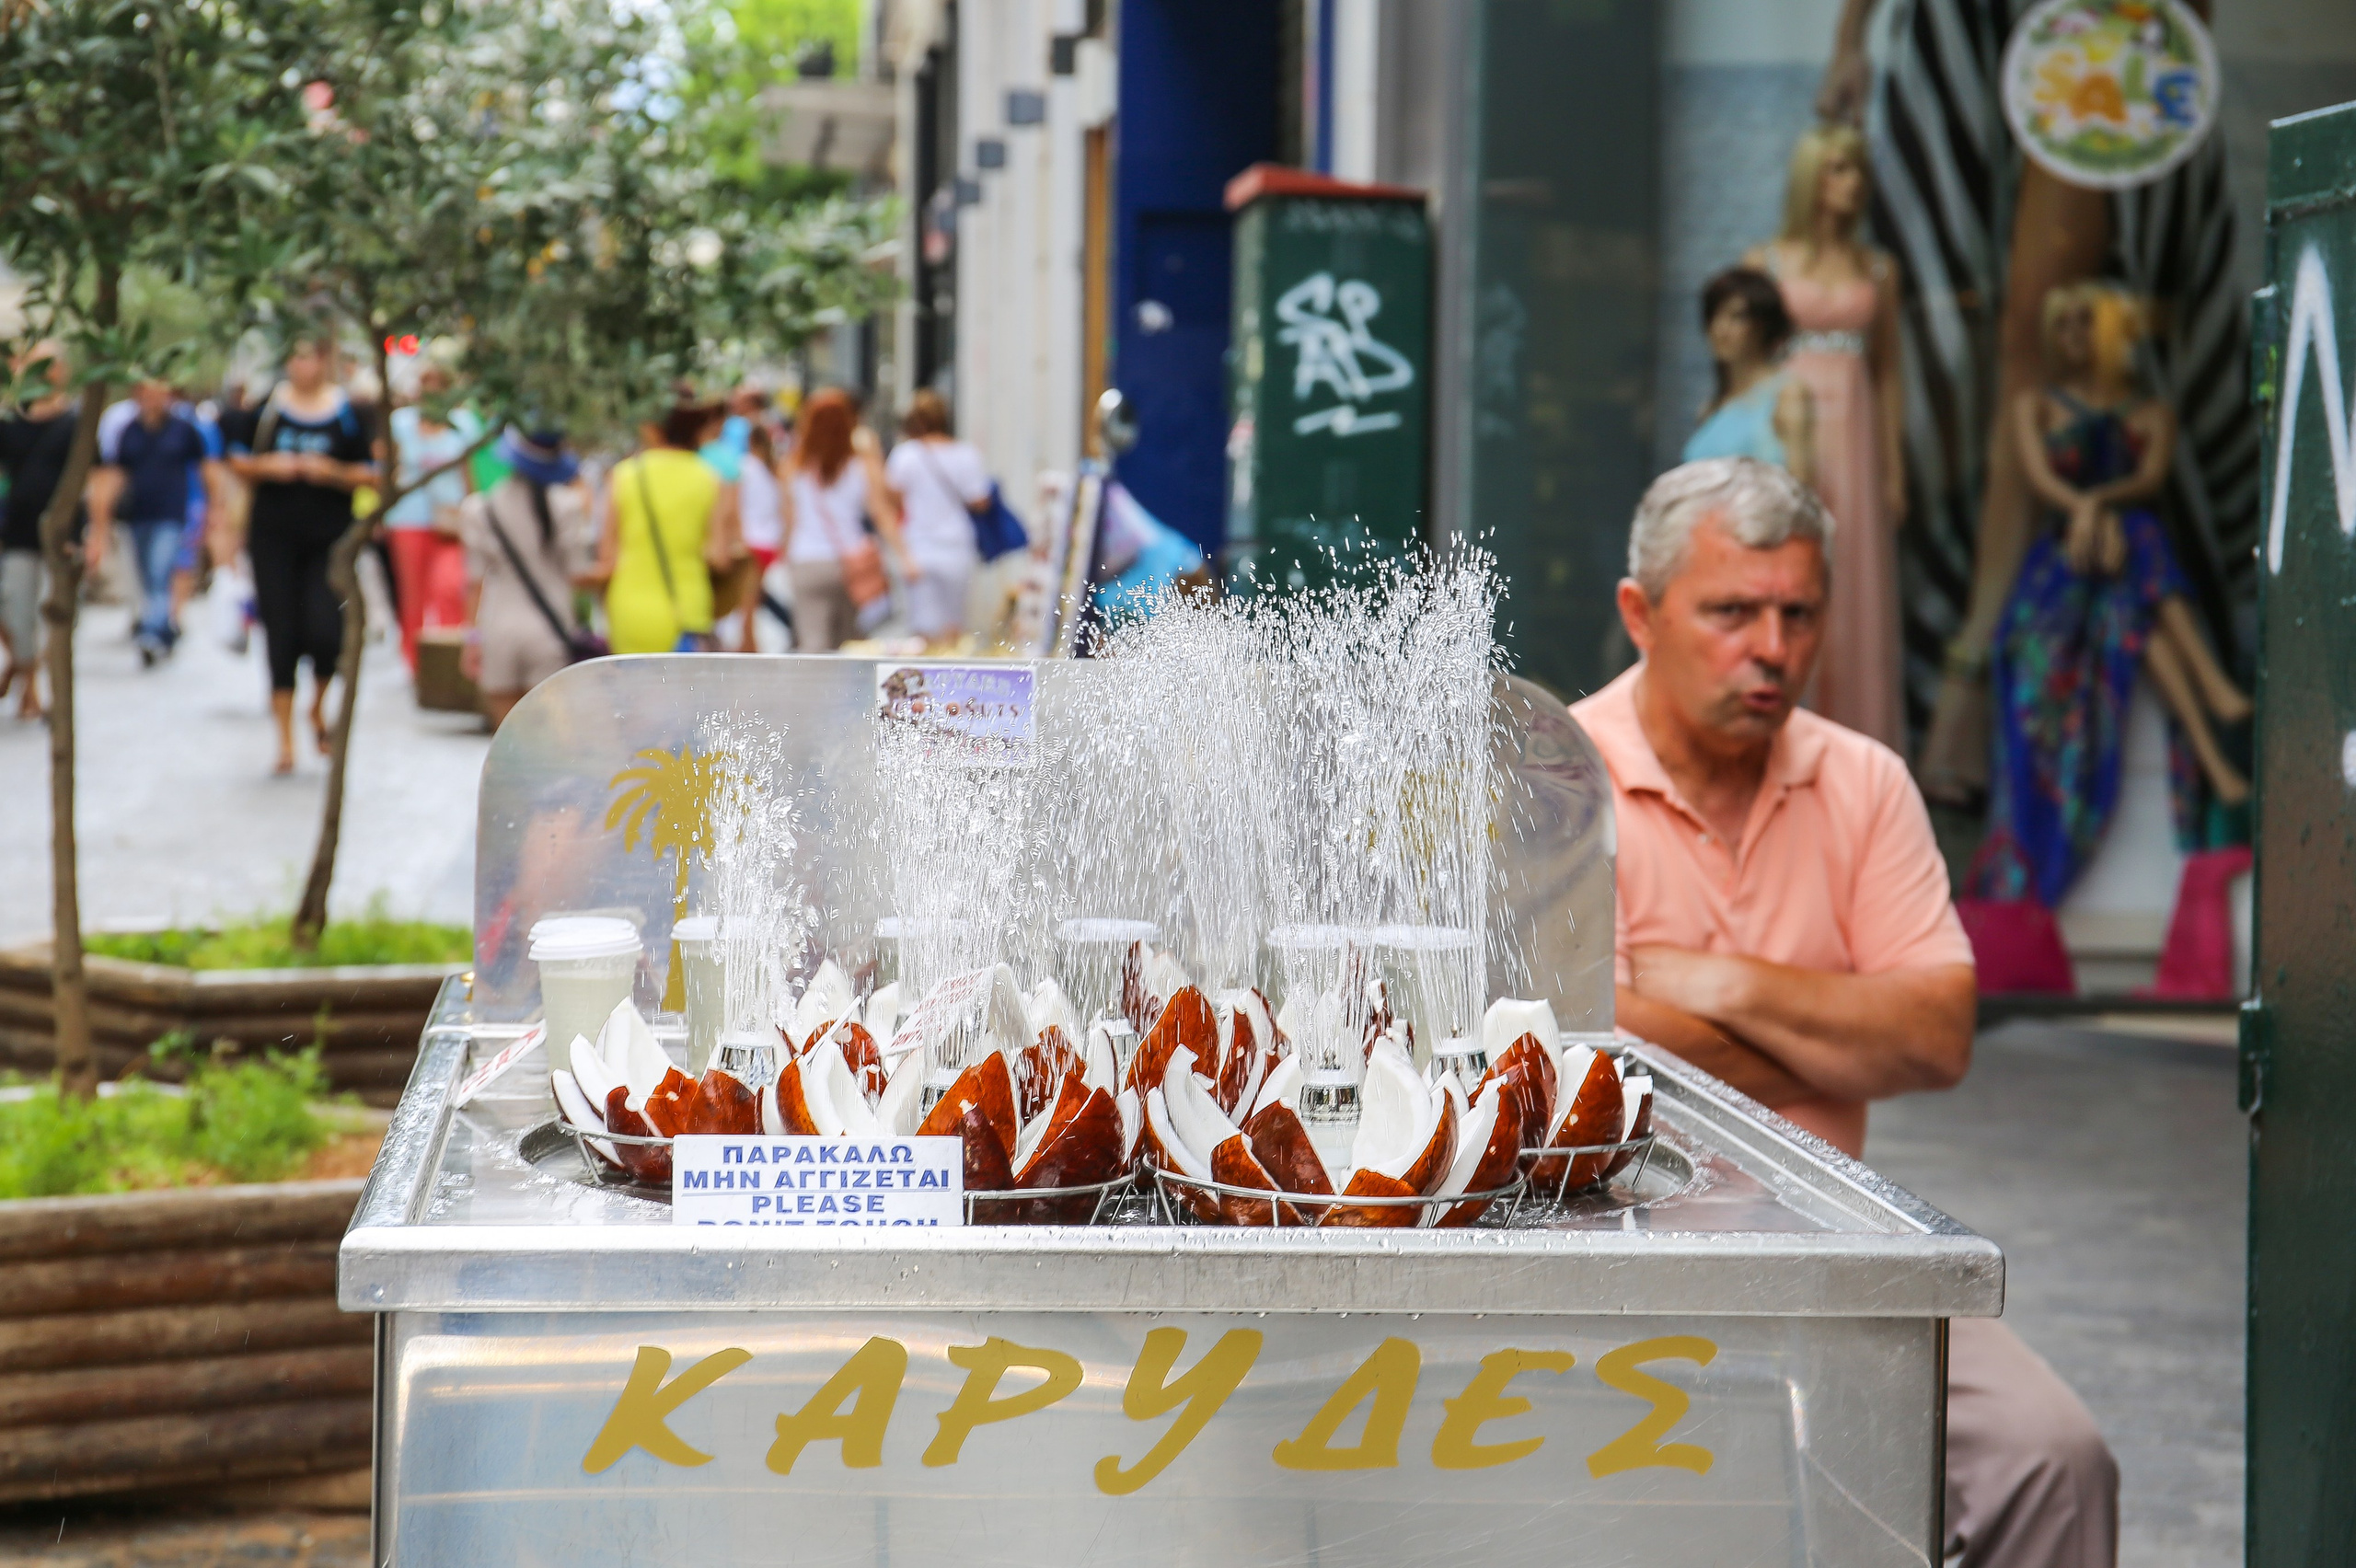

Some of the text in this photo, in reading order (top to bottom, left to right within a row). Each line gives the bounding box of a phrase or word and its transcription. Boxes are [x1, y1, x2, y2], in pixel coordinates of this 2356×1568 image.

[722, 1145, 914, 1164] ΠΑΡΑΚΑΛΩ
[683, 1170, 950, 1190] ΜΗΝ ΑΓΓΙΖΕΤΑΙ
[752, 1194, 885, 1214] PLEASE
[582, 1328, 1718, 1495] ΚΑΡΥΔΕΣ
